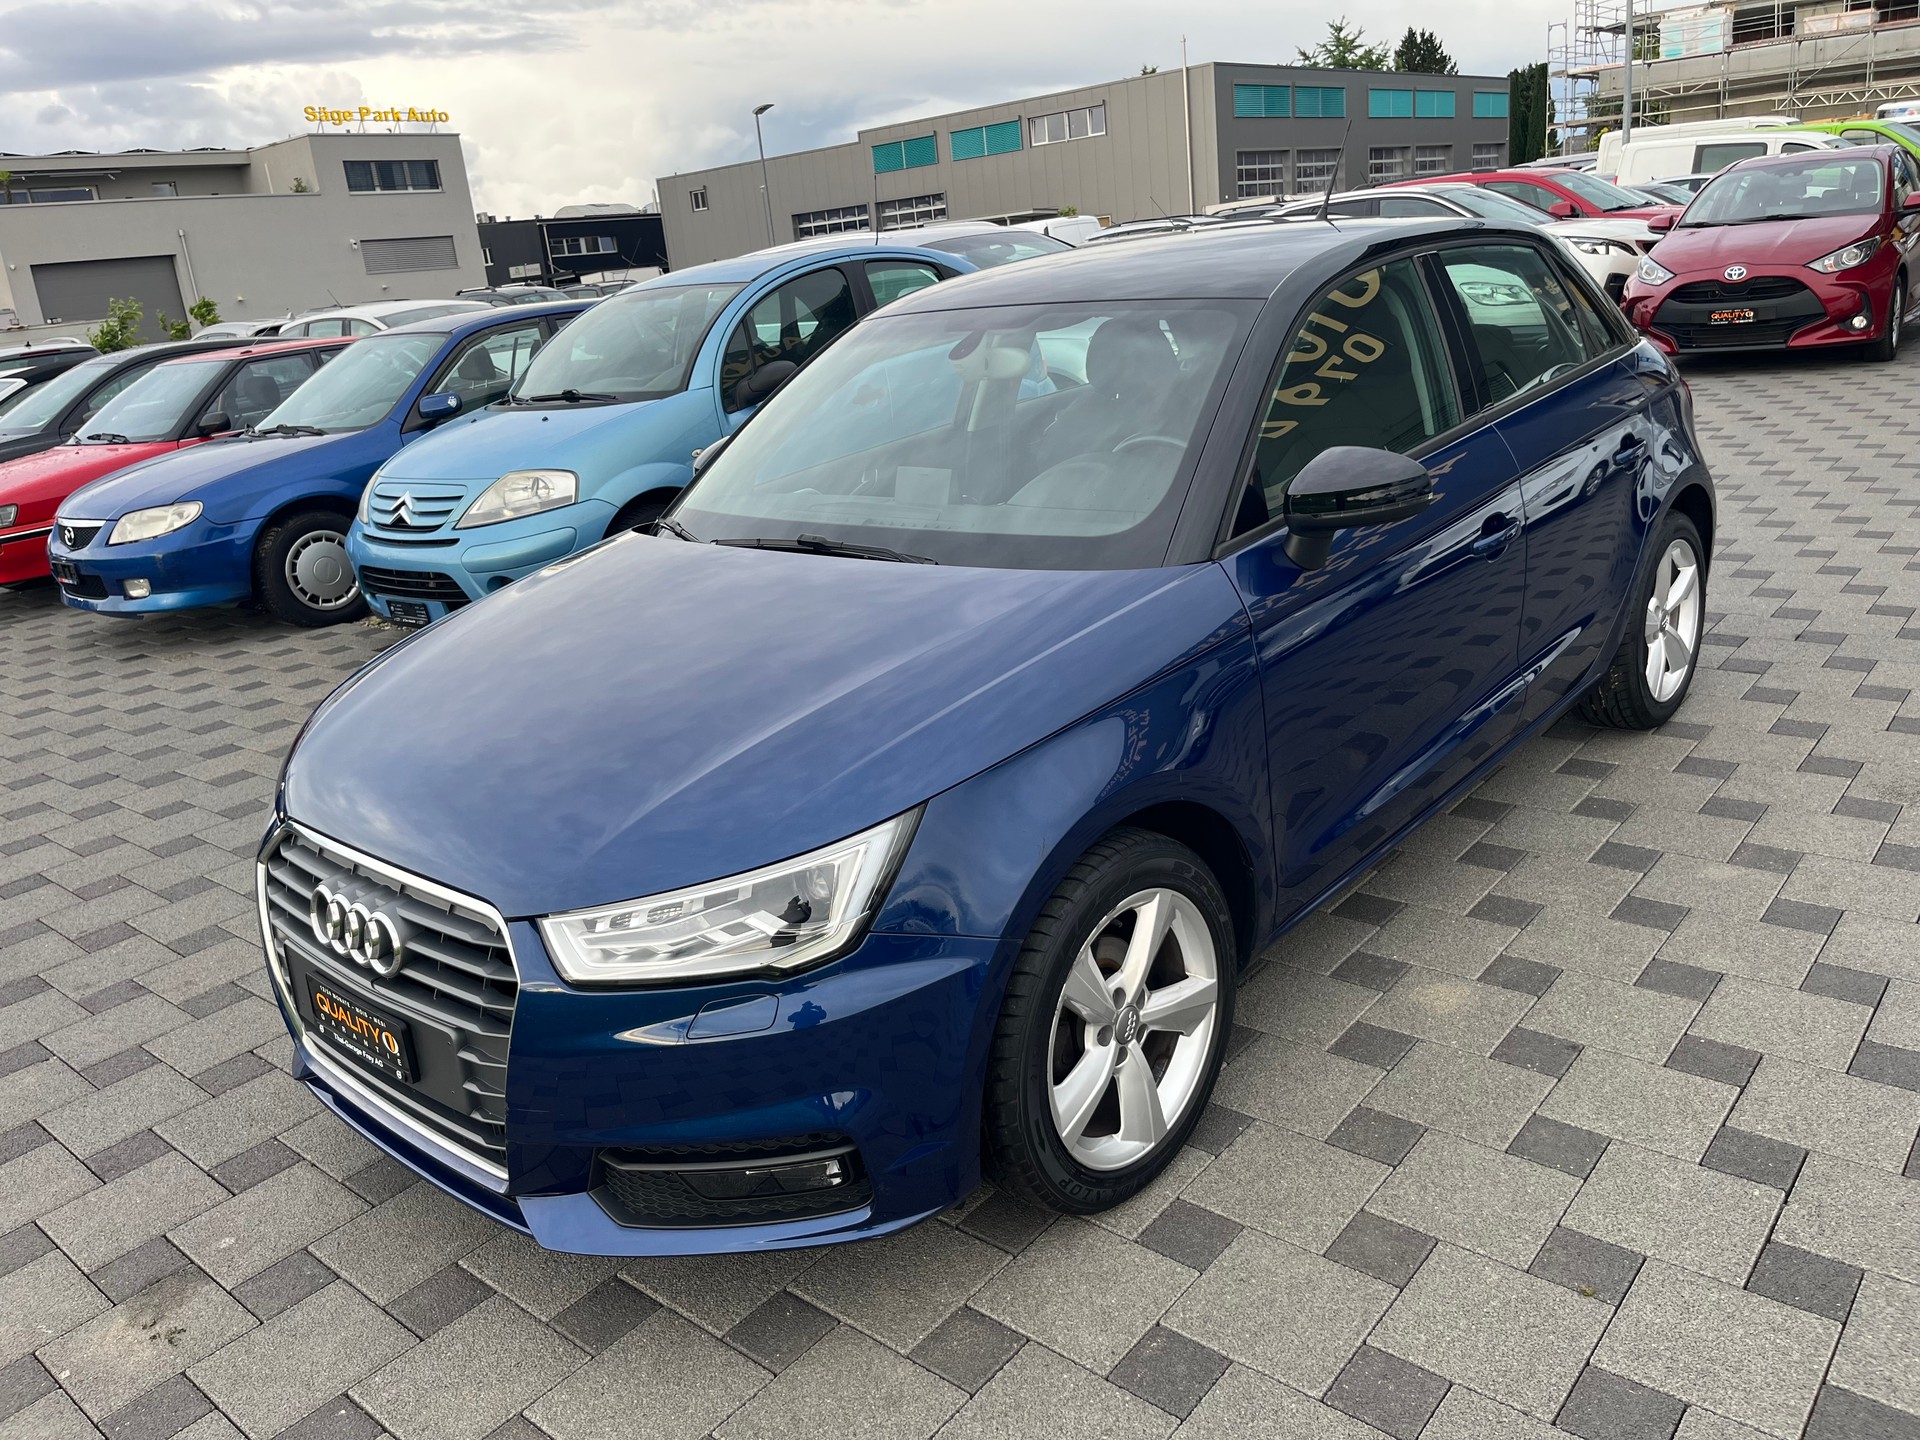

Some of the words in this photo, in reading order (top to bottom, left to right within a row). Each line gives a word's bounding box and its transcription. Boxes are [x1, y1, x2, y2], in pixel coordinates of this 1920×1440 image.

[303, 105, 354, 126] Säge
[358, 106, 402, 122] Park
[407, 106, 450, 123] Auto
[1711, 311, 1745, 319] QUALITY
[316, 992, 380, 1044] QUALITY
